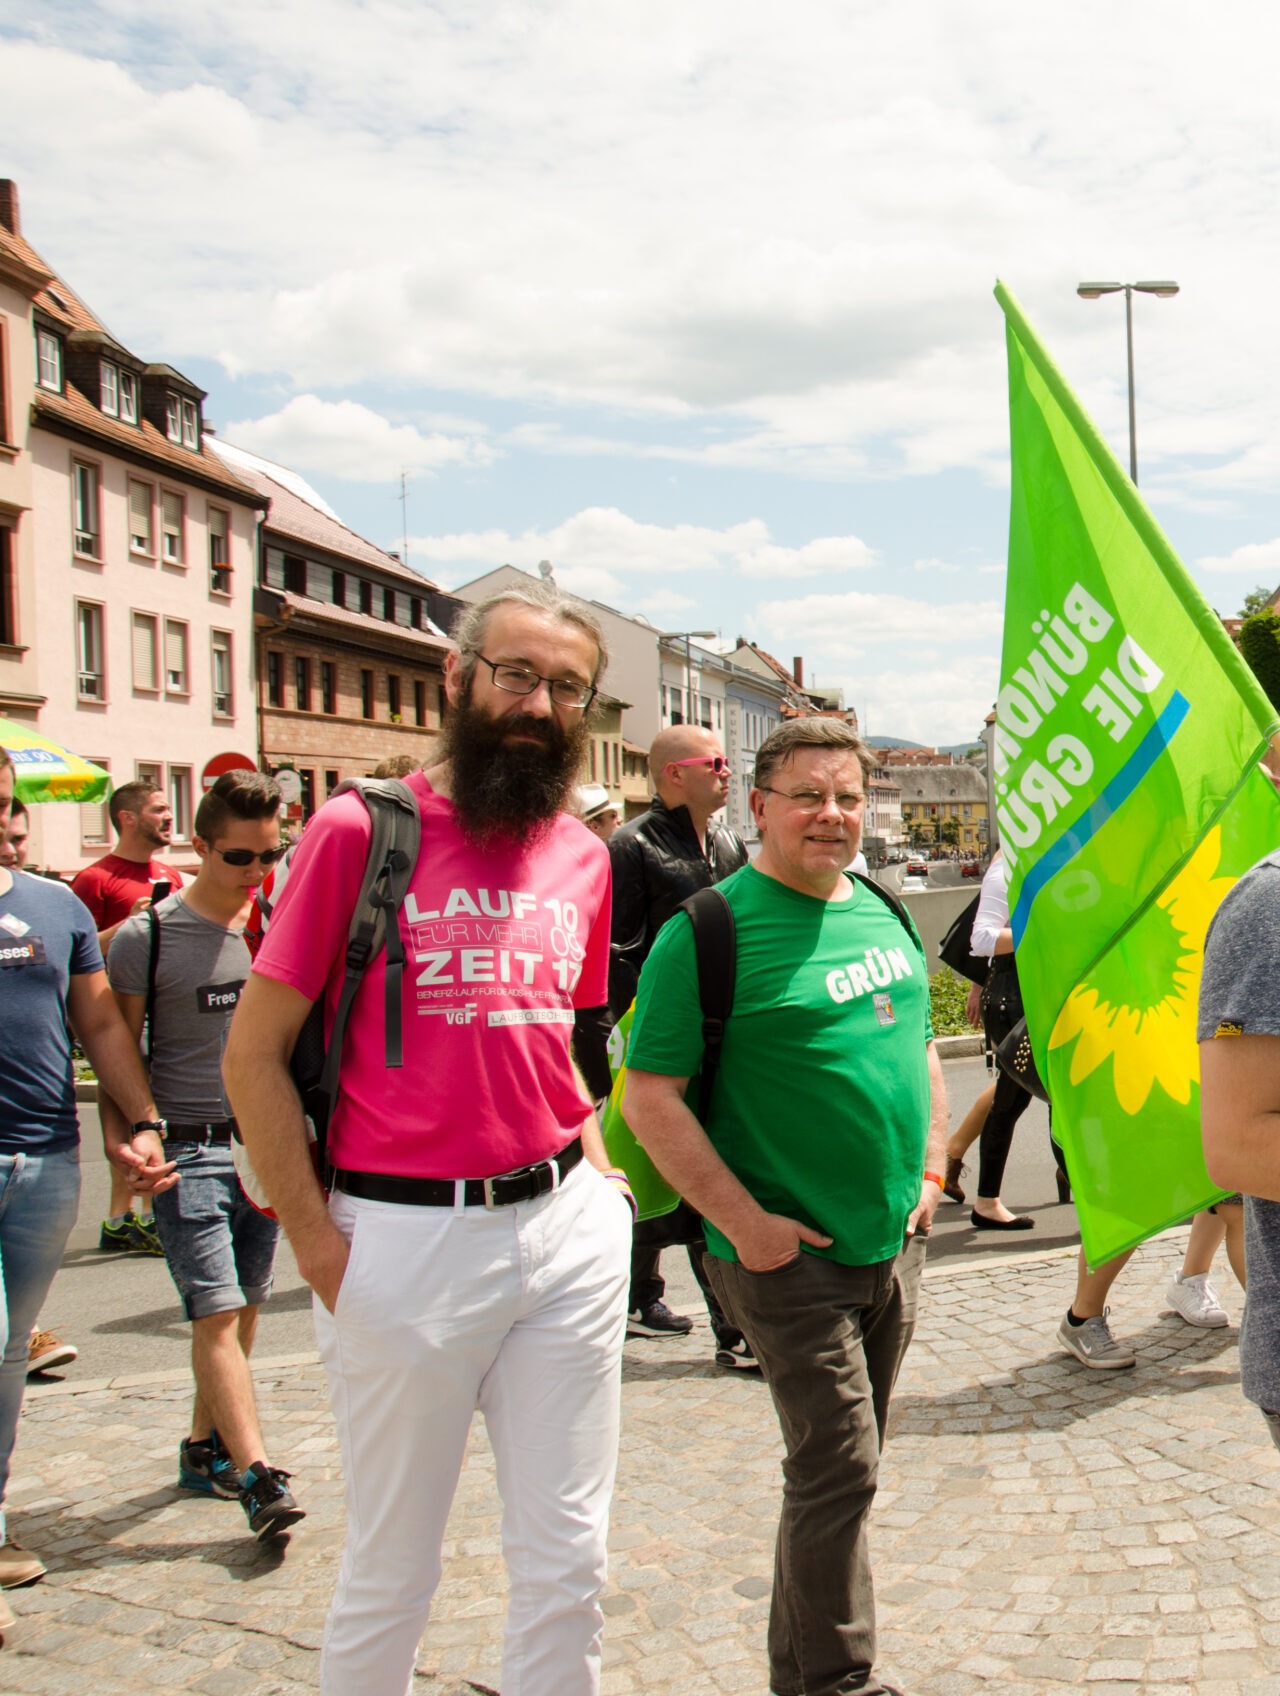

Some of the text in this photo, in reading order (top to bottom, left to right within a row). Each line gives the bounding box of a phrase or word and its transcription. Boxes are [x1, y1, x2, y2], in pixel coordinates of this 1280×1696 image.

[404, 888, 578, 933] LAUF 10
[415, 923, 470, 947] FÜR
[475, 923, 539, 947] MEHR
[416, 949, 582, 993] ZEIT 17
[825, 947, 913, 1004] GRÜN
[207, 992, 237, 1007] Free
